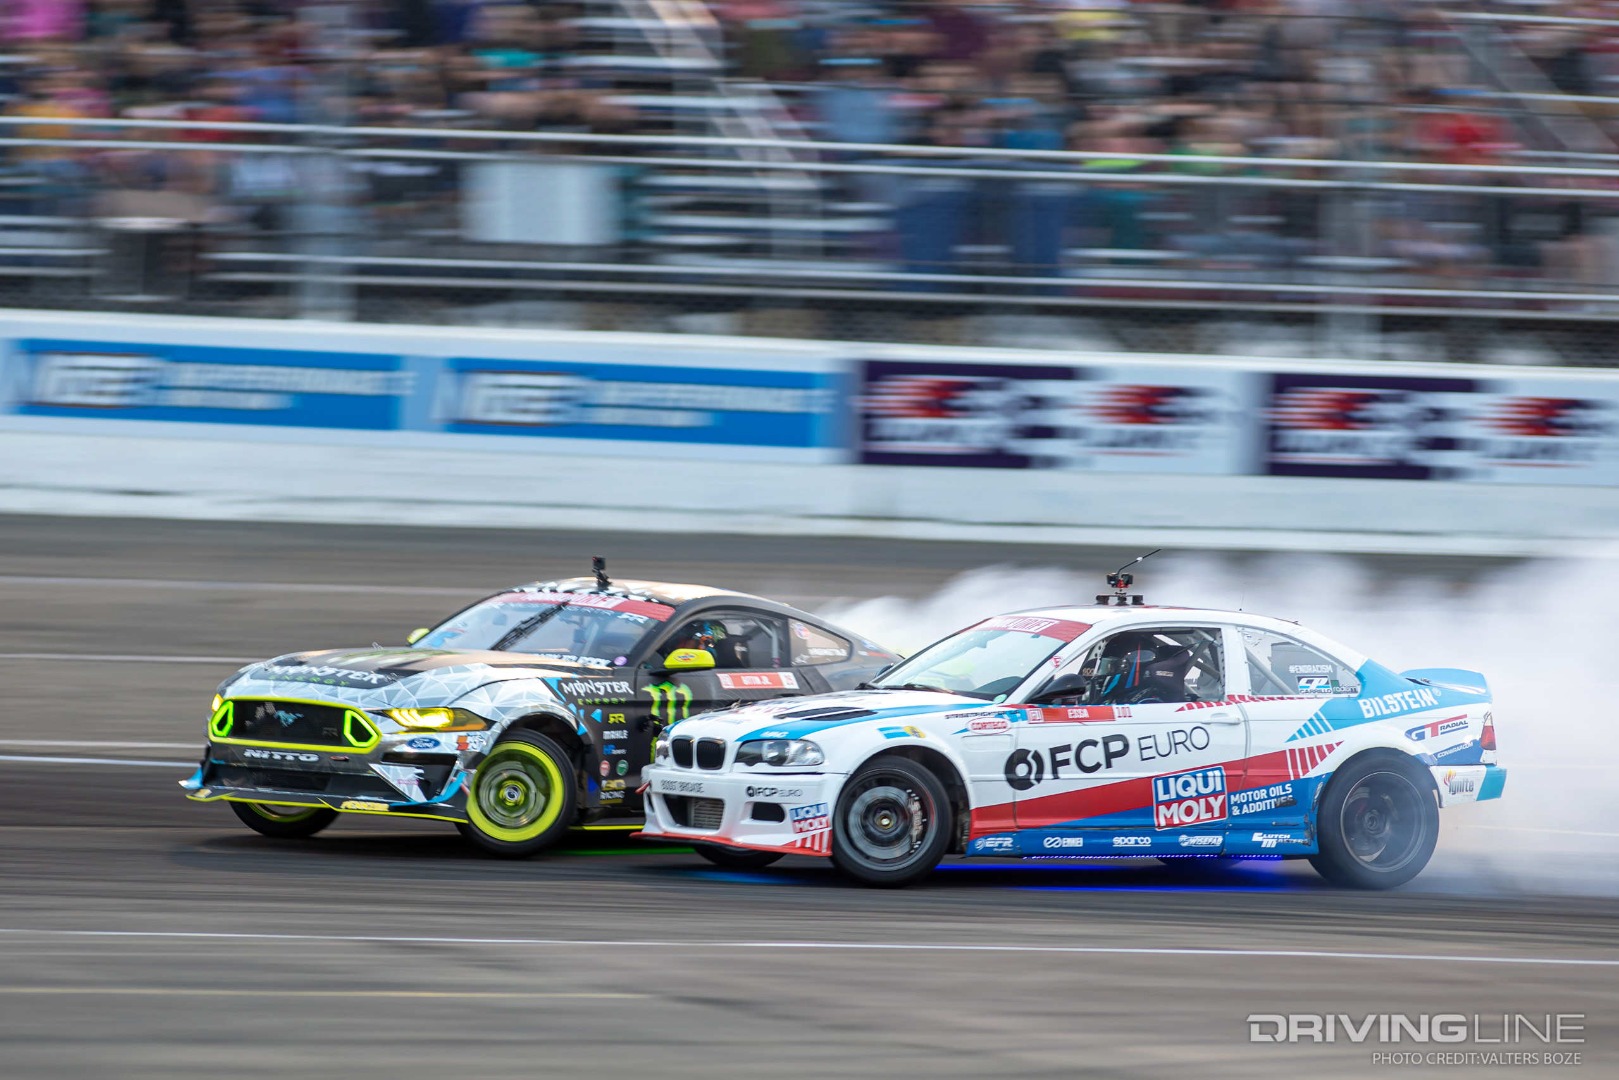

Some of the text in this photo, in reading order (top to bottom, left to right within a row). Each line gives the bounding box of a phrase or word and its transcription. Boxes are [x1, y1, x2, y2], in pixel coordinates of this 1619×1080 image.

[561, 680, 634, 697] MONSTER
[1440, 720, 1469, 731] RADIAL
[1049, 725, 1211, 780] FCP EURO
[754, 787, 778, 798] FCP
[1157, 768, 1223, 801] LIQUI
[1230, 784, 1293, 805] MOTOR OILS
[792, 804, 827, 820] LIQUI
[1158, 794, 1226, 827] MOLY
[1231, 805, 1240, 816] &
[794, 817, 830, 833] MOLY
[1112, 836, 1152, 846] sparco
[1252, 832, 1291, 842] CLUTCH
